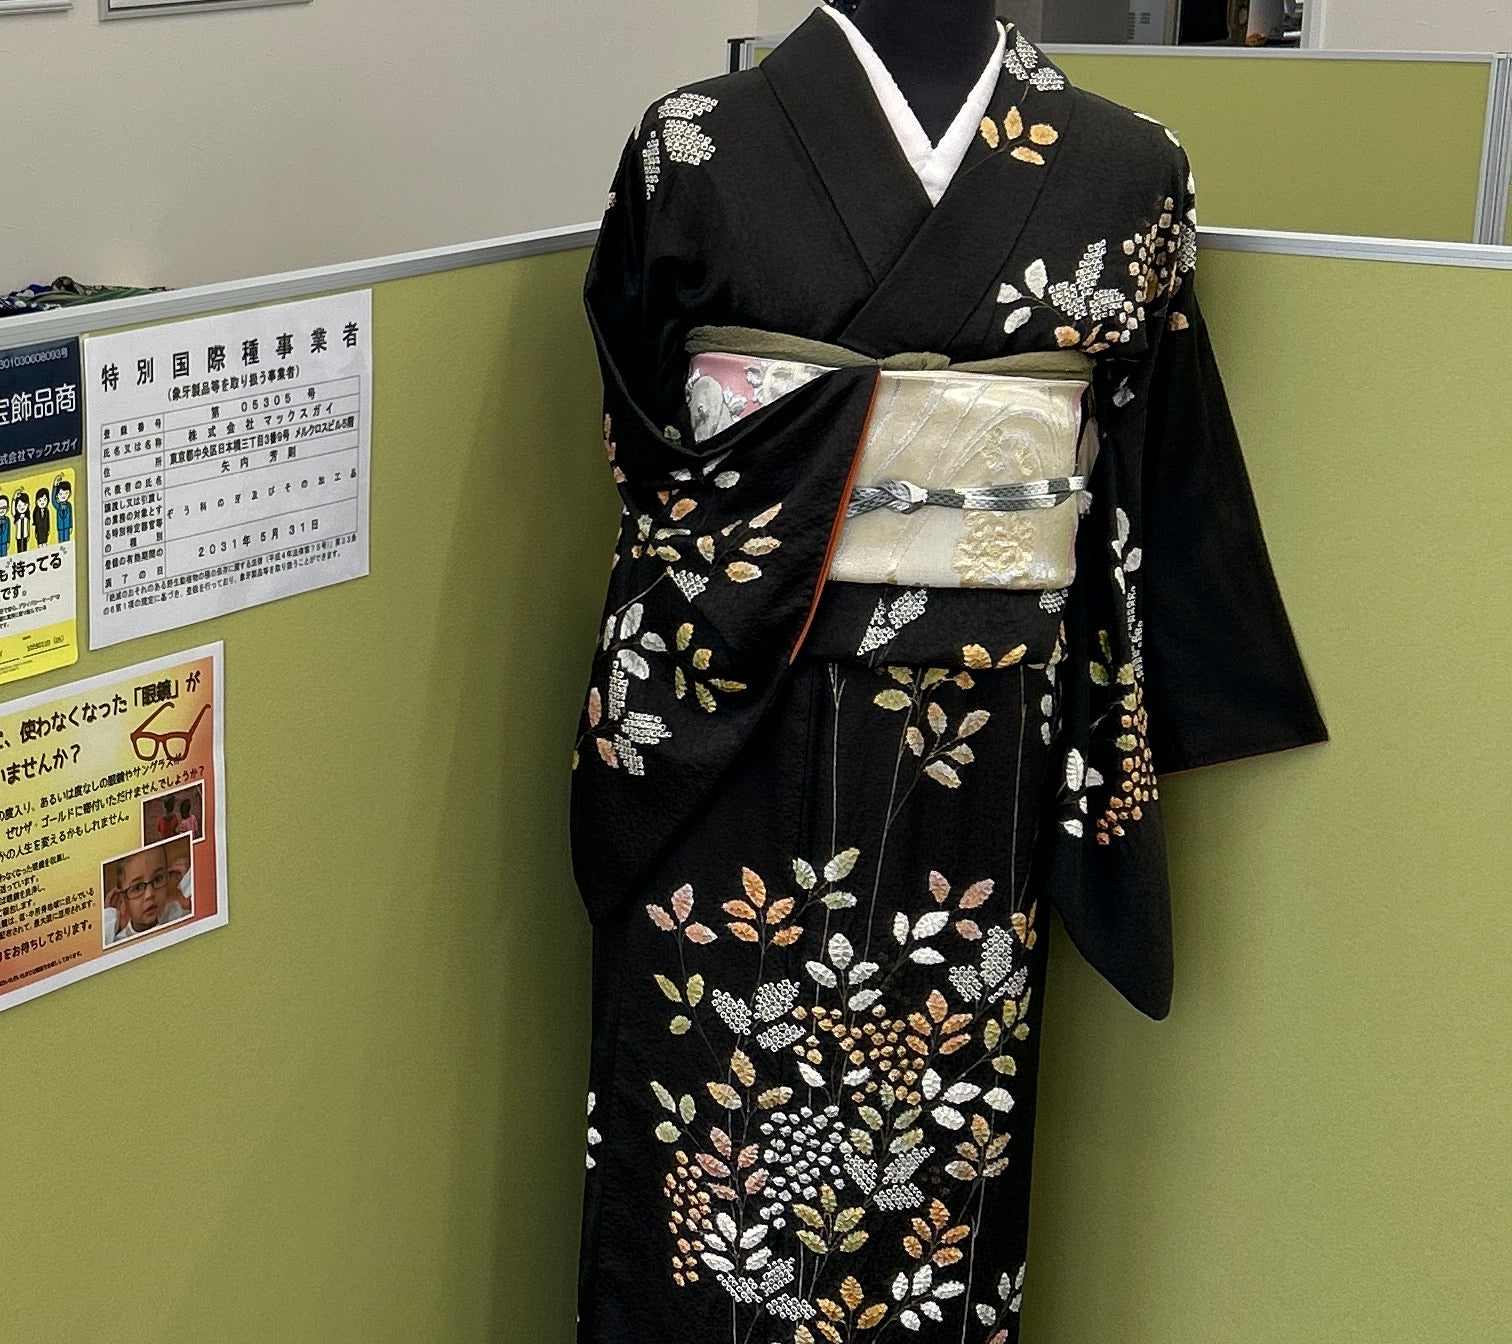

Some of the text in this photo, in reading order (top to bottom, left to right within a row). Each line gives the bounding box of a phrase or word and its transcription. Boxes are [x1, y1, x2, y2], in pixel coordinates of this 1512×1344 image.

[101, 321, 359, 393] 特別国際種事業者
